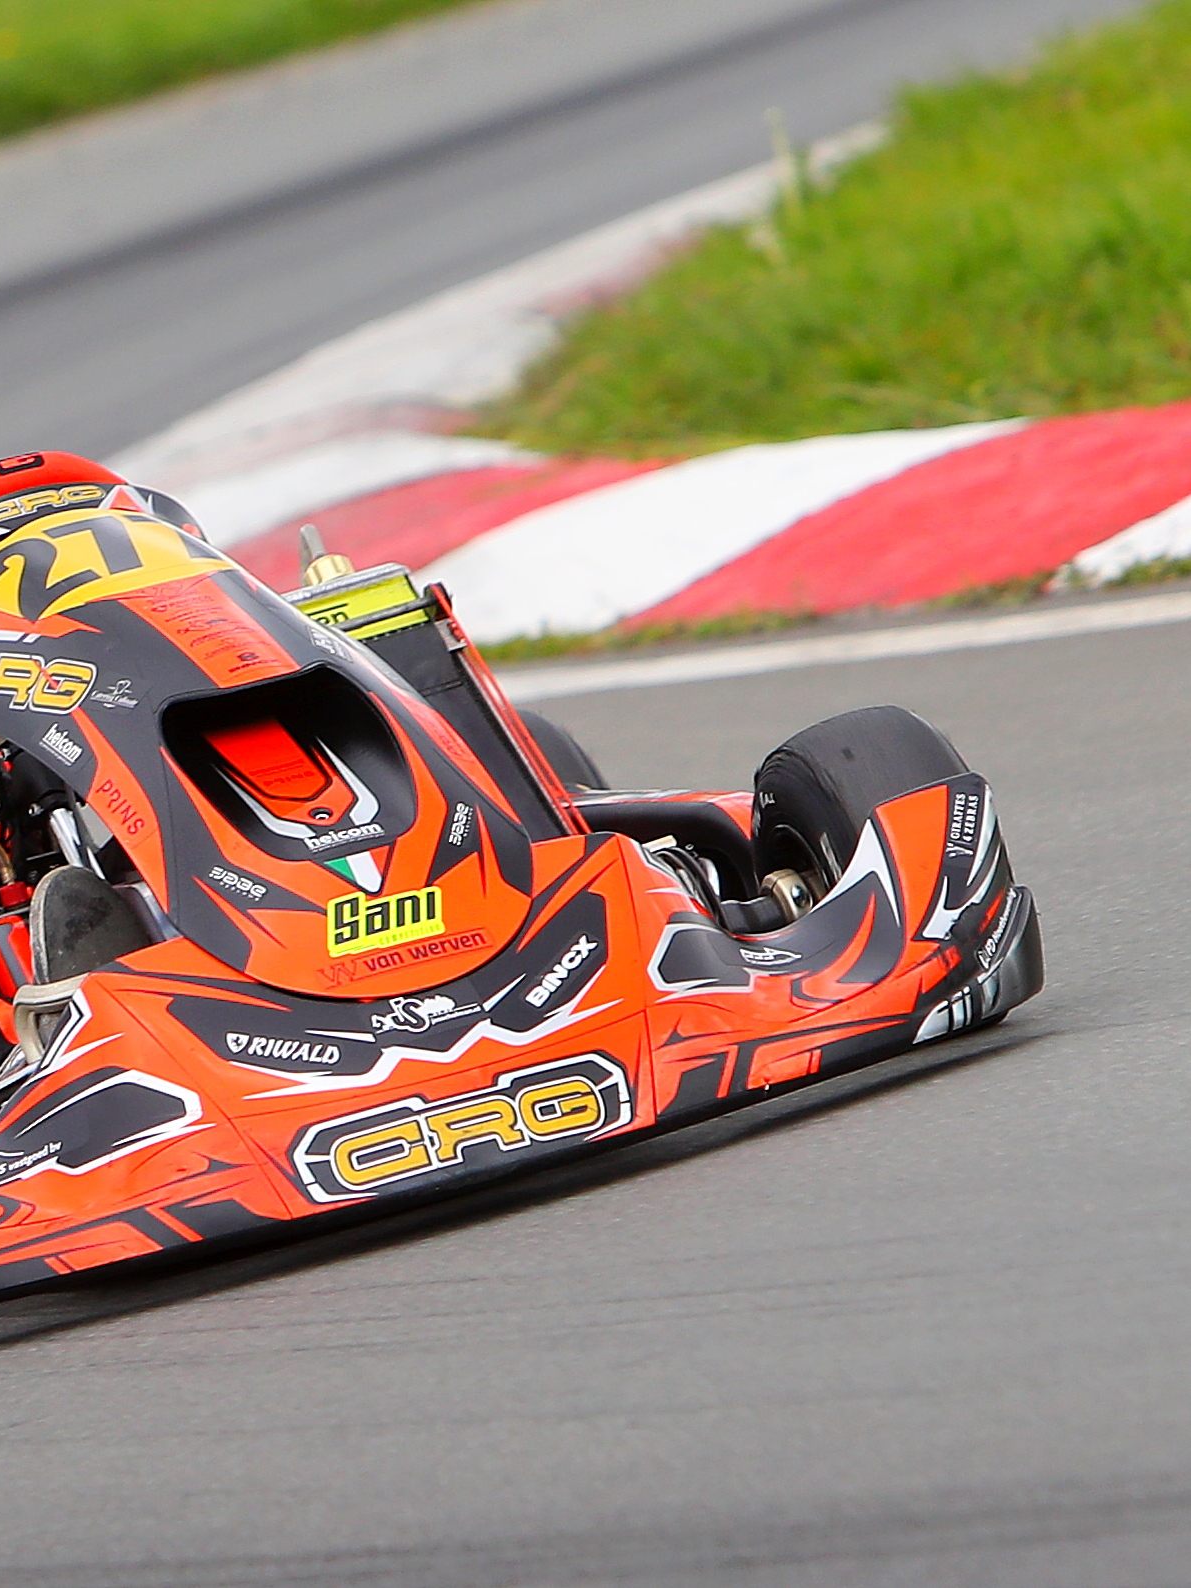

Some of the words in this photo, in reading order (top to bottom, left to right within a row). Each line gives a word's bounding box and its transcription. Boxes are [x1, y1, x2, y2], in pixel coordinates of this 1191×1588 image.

[96, 779, 144, 836] PRINS
[364, 952, 405, 972] van
[409, 932, 487, 961] werven
[525, 934, 598, 1008] BINCX
[248, 1037, 341, 1064] RIWALD
[330, 1075, 606, 1191] CRG
